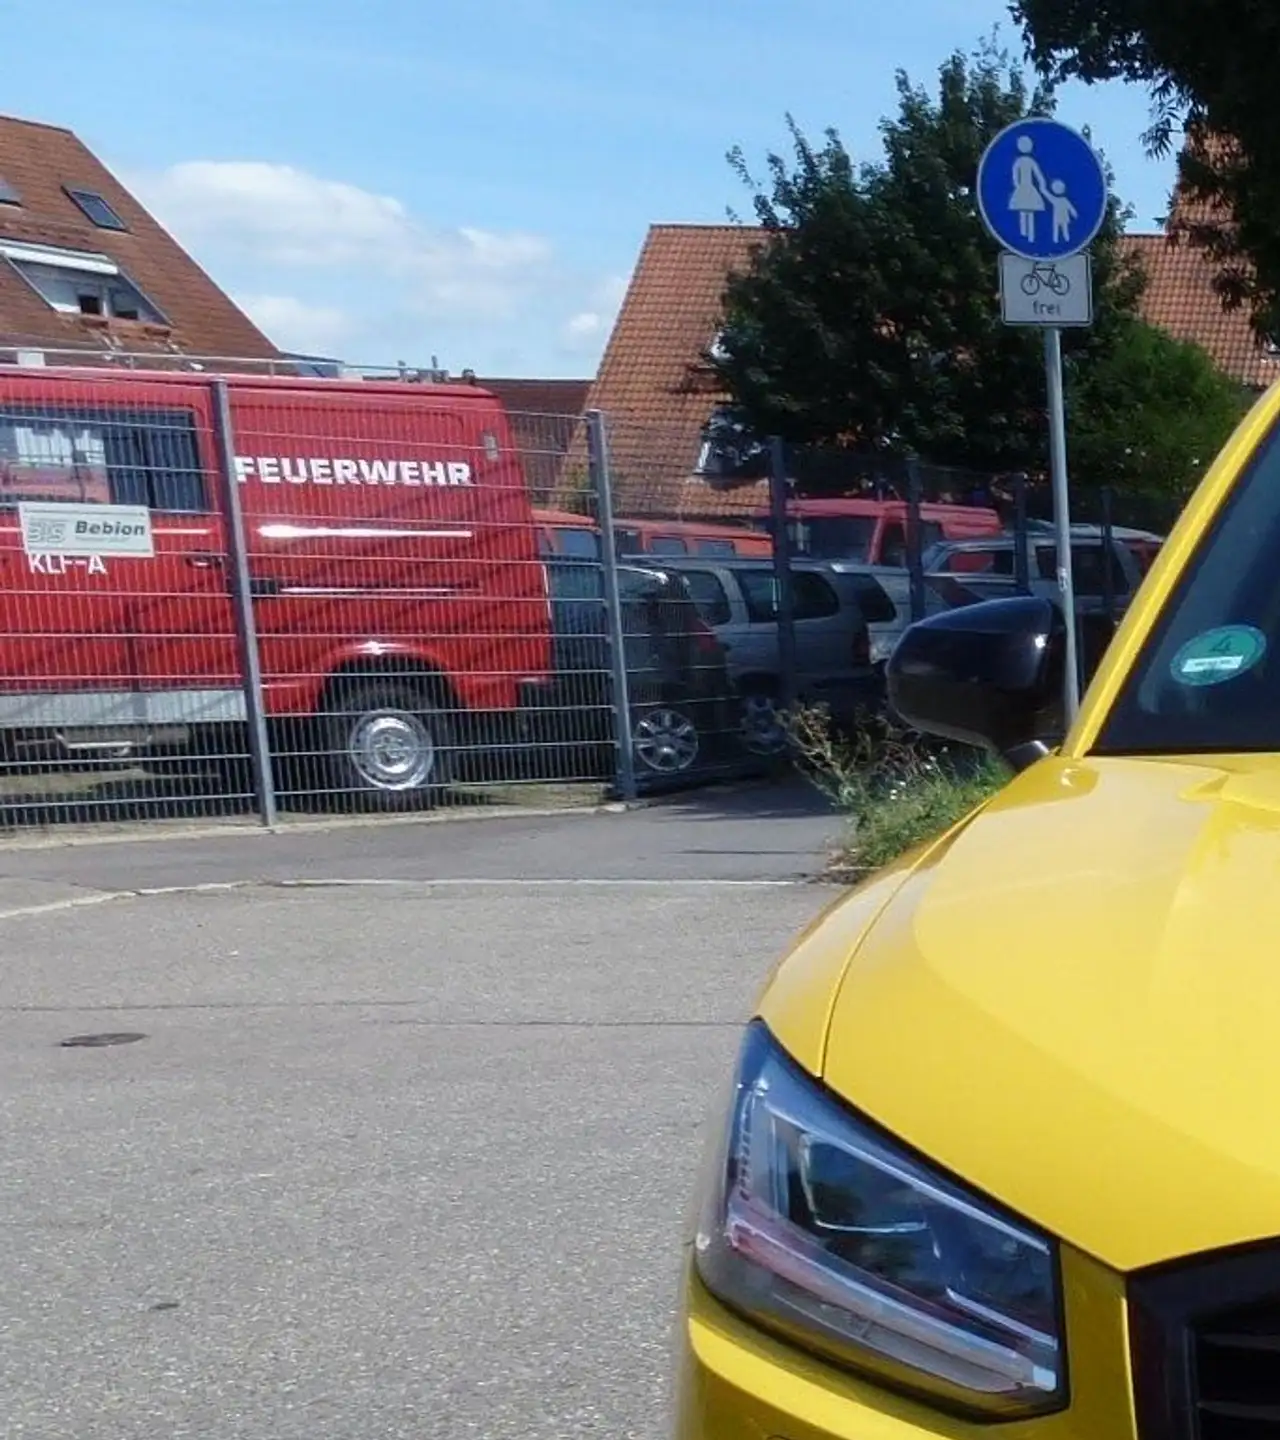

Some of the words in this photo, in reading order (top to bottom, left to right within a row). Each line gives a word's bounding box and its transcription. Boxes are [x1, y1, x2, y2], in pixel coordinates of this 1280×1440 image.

[1032, 300, 1061, 316] frei
[233, 456, 471, 486] FEUERWEHR
[75, 520, 146, 536] Bebion
